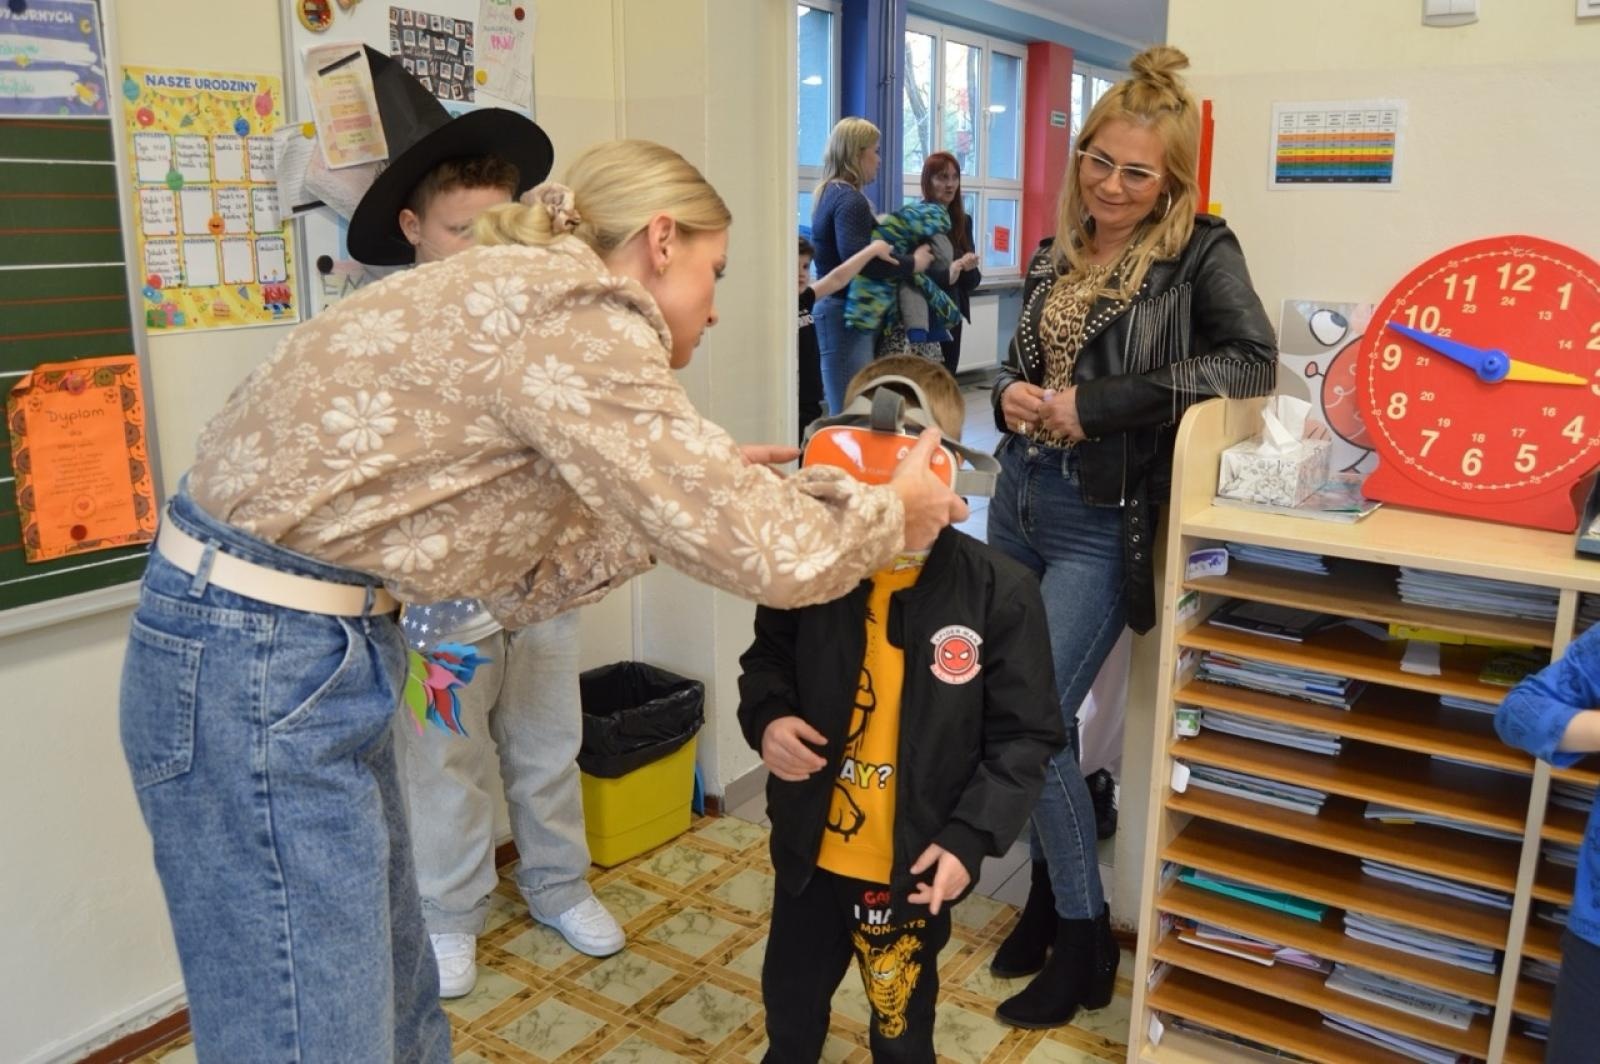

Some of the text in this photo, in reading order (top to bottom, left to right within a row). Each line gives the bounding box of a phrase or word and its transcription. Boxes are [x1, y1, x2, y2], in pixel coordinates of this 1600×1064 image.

[146, 75, 258, 93] NASZE URODZINY
[1496, 262, 1536, 293] 12
[1444, 273, 1478, 303] 11
[1557, 282, 1573, 311] 1
[1462, 304, 1477, 315] 23
[1500, 296, 1516, 307] 24
[1404, 304, 1441, 334] 10
[1538, 311, 1553, 321] 13
[1438, 328, 1452, 338] 22
[1559, 340, 1573, 350] 14
[1381, 344, 1402, 371] 9
[1416, 356, 1430, 367] 21
[1420, 391, 1435, 402] 20
[1387, 392, 1409, 420] 8
[1542, 406, 1557, 417] 16
[45, 408, 105, 429] Dyplom
[1437, 417, 1451, 428] 19
[1472, 432, 1486, 444] 18
[1512, 428, 1527, 438] 17
[1561, 415, 1586, 445] 4
[1420, 429, 1441, 457] 7
[1461, 447, 1484, 477] 6
[1514, 443, 1539, 473] 5
[854, 903, 861, 920] I
[860, 918, 926, 936] MONYS
